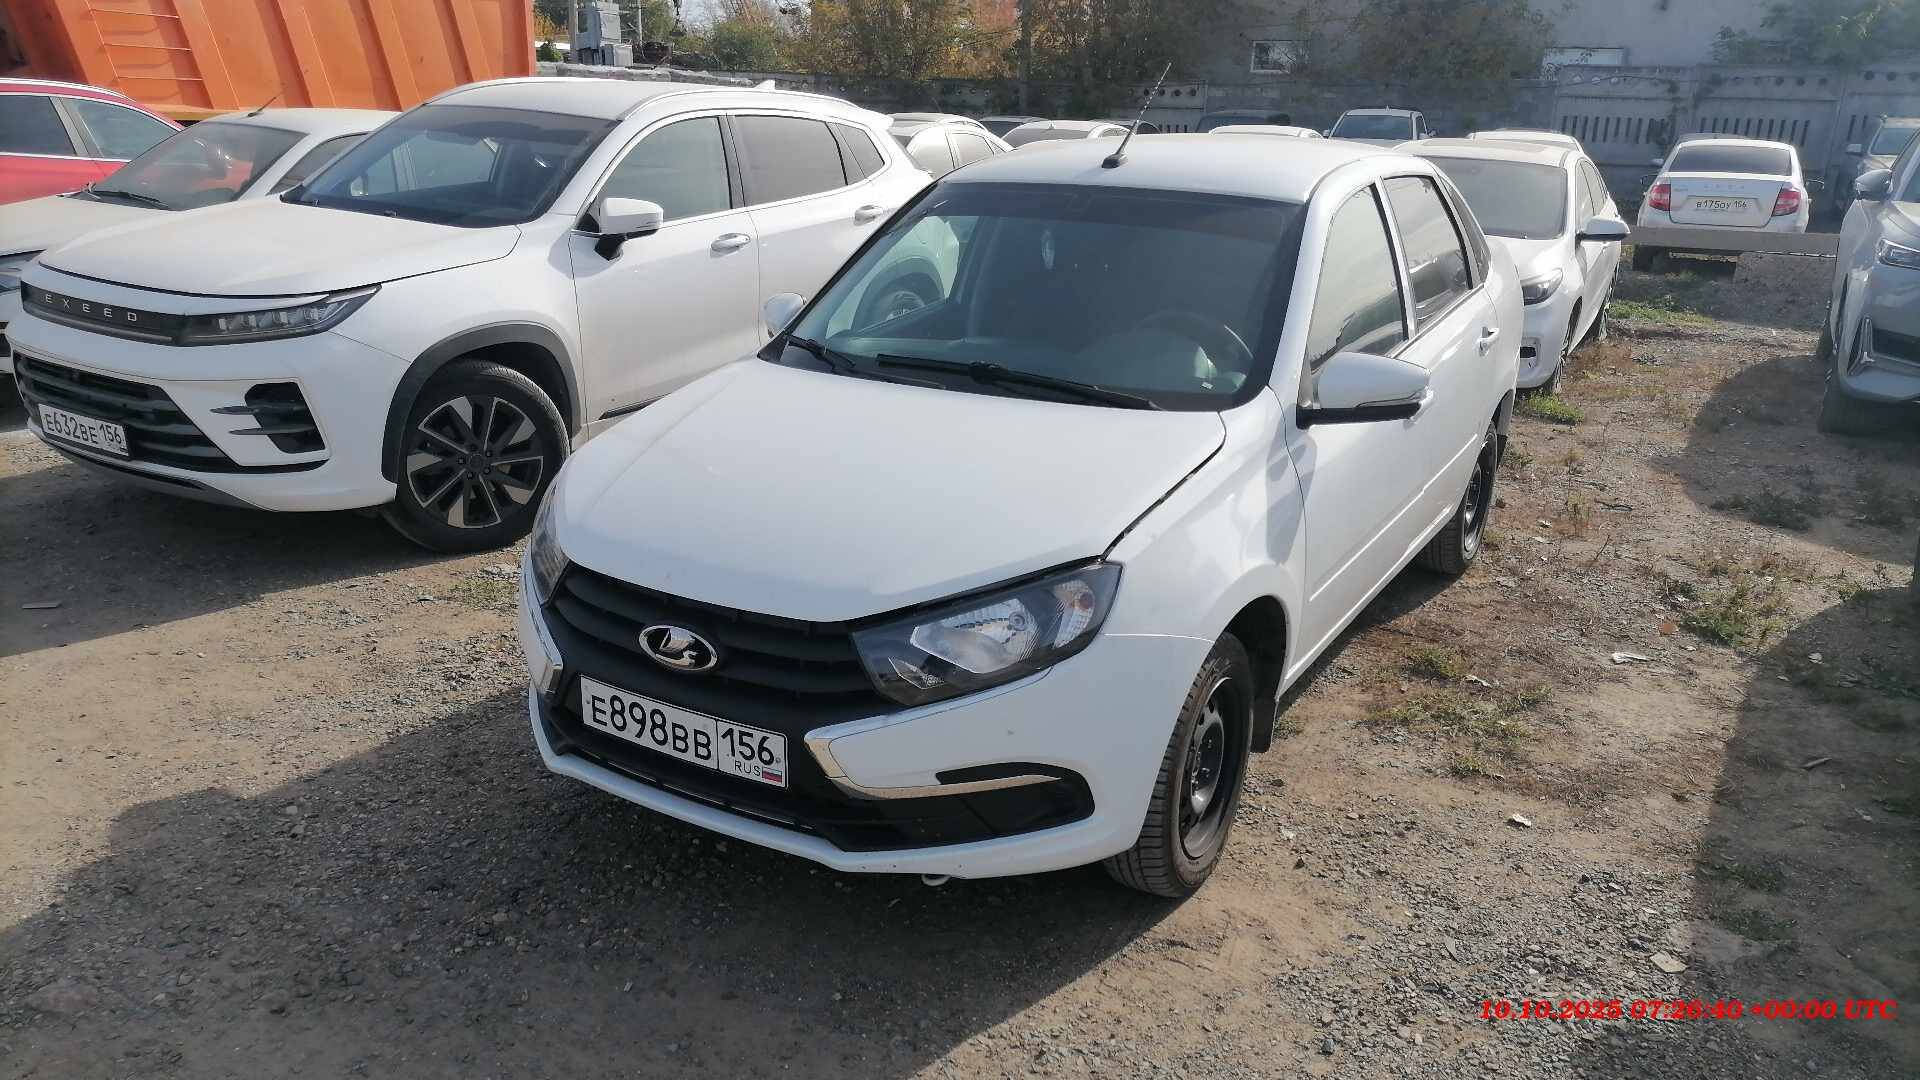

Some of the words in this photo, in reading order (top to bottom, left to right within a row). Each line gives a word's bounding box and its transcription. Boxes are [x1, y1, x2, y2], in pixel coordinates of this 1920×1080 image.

[45, 293, 137, 322] EXEED
[720, 727, 775, 766] 156
[734, 760, 761, 776] RUS
